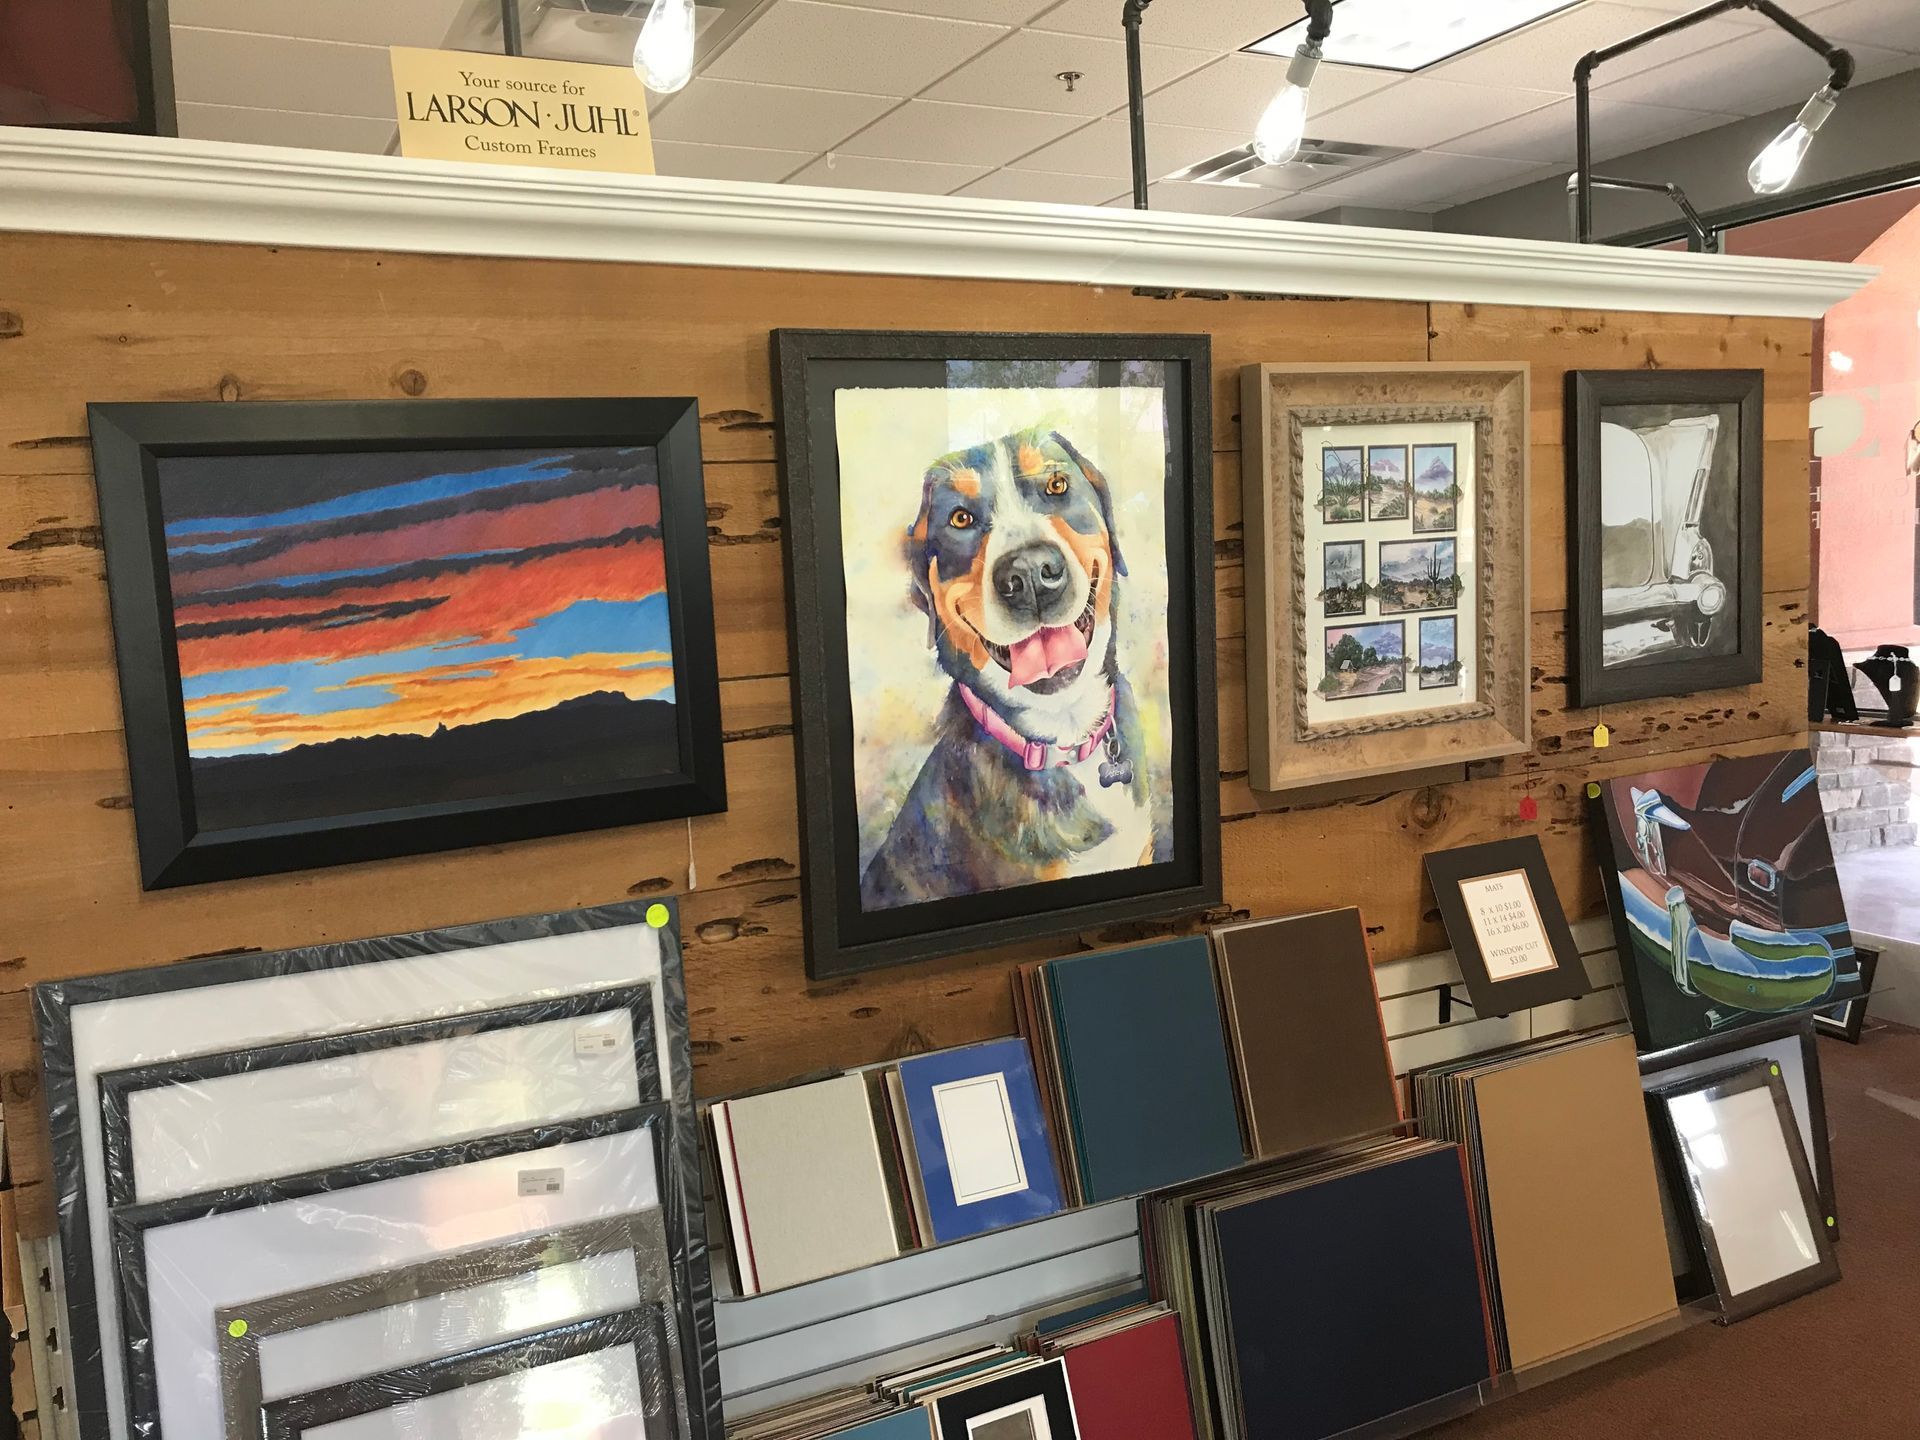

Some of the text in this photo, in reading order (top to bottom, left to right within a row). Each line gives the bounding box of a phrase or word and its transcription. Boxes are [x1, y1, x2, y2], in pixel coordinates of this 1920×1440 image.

[458, 71, 585, 96] Your source for
[464, 135, 597, 158] Custom Frames
[1484, 883, 1504, 893] MATS
[1495, 903, 1503, 913] 10
[1504, 900, 1521, 911] $1.00
[1499, 914, 1507, 923] 14
[1509, 910, 1526, 921] $4.00
[1486, 927, 1495, 936] 16
[1503, 924, 1511, 934] 20
[1512, 920, 1529, 931] $6.00
[1490, 941, 1539, 958] WINDOW CUT
[1510, 953, 1528, 966] $3.00
